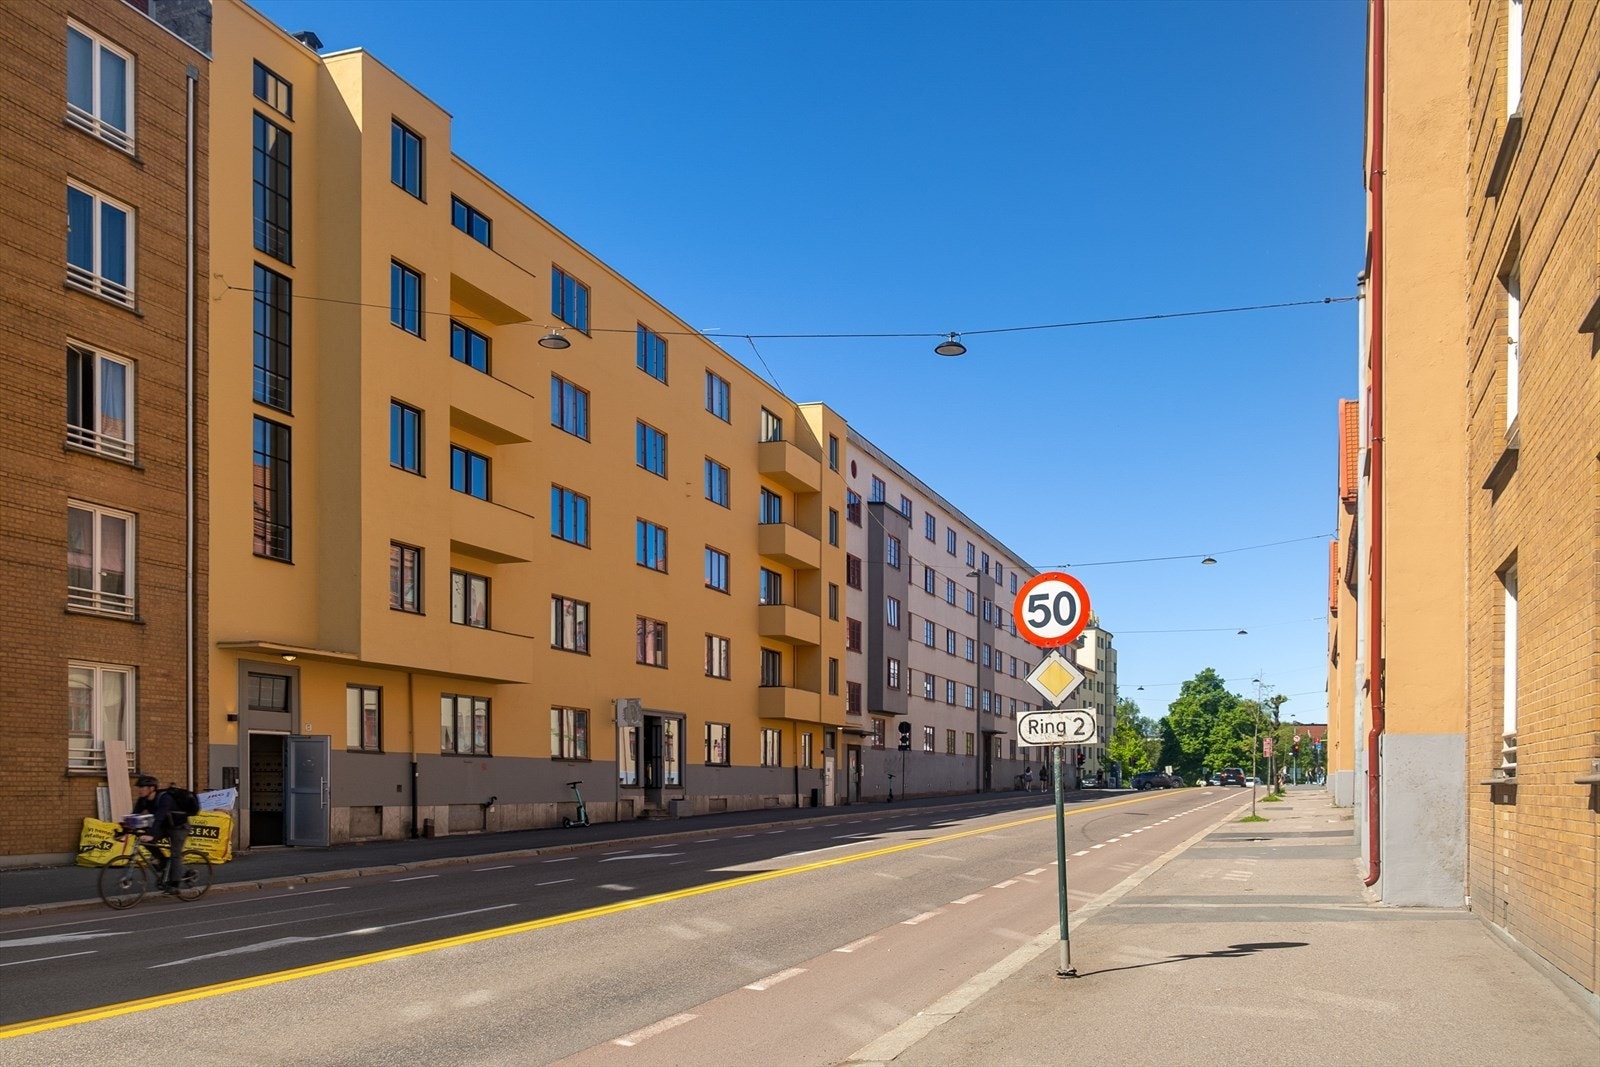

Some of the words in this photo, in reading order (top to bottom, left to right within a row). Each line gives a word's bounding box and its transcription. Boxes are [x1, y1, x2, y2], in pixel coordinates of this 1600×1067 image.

[1028, 591, 1076, 628] 50
[1029, 719, 1066, 737] Ring
[1073, 717, 1085, 735] 2
